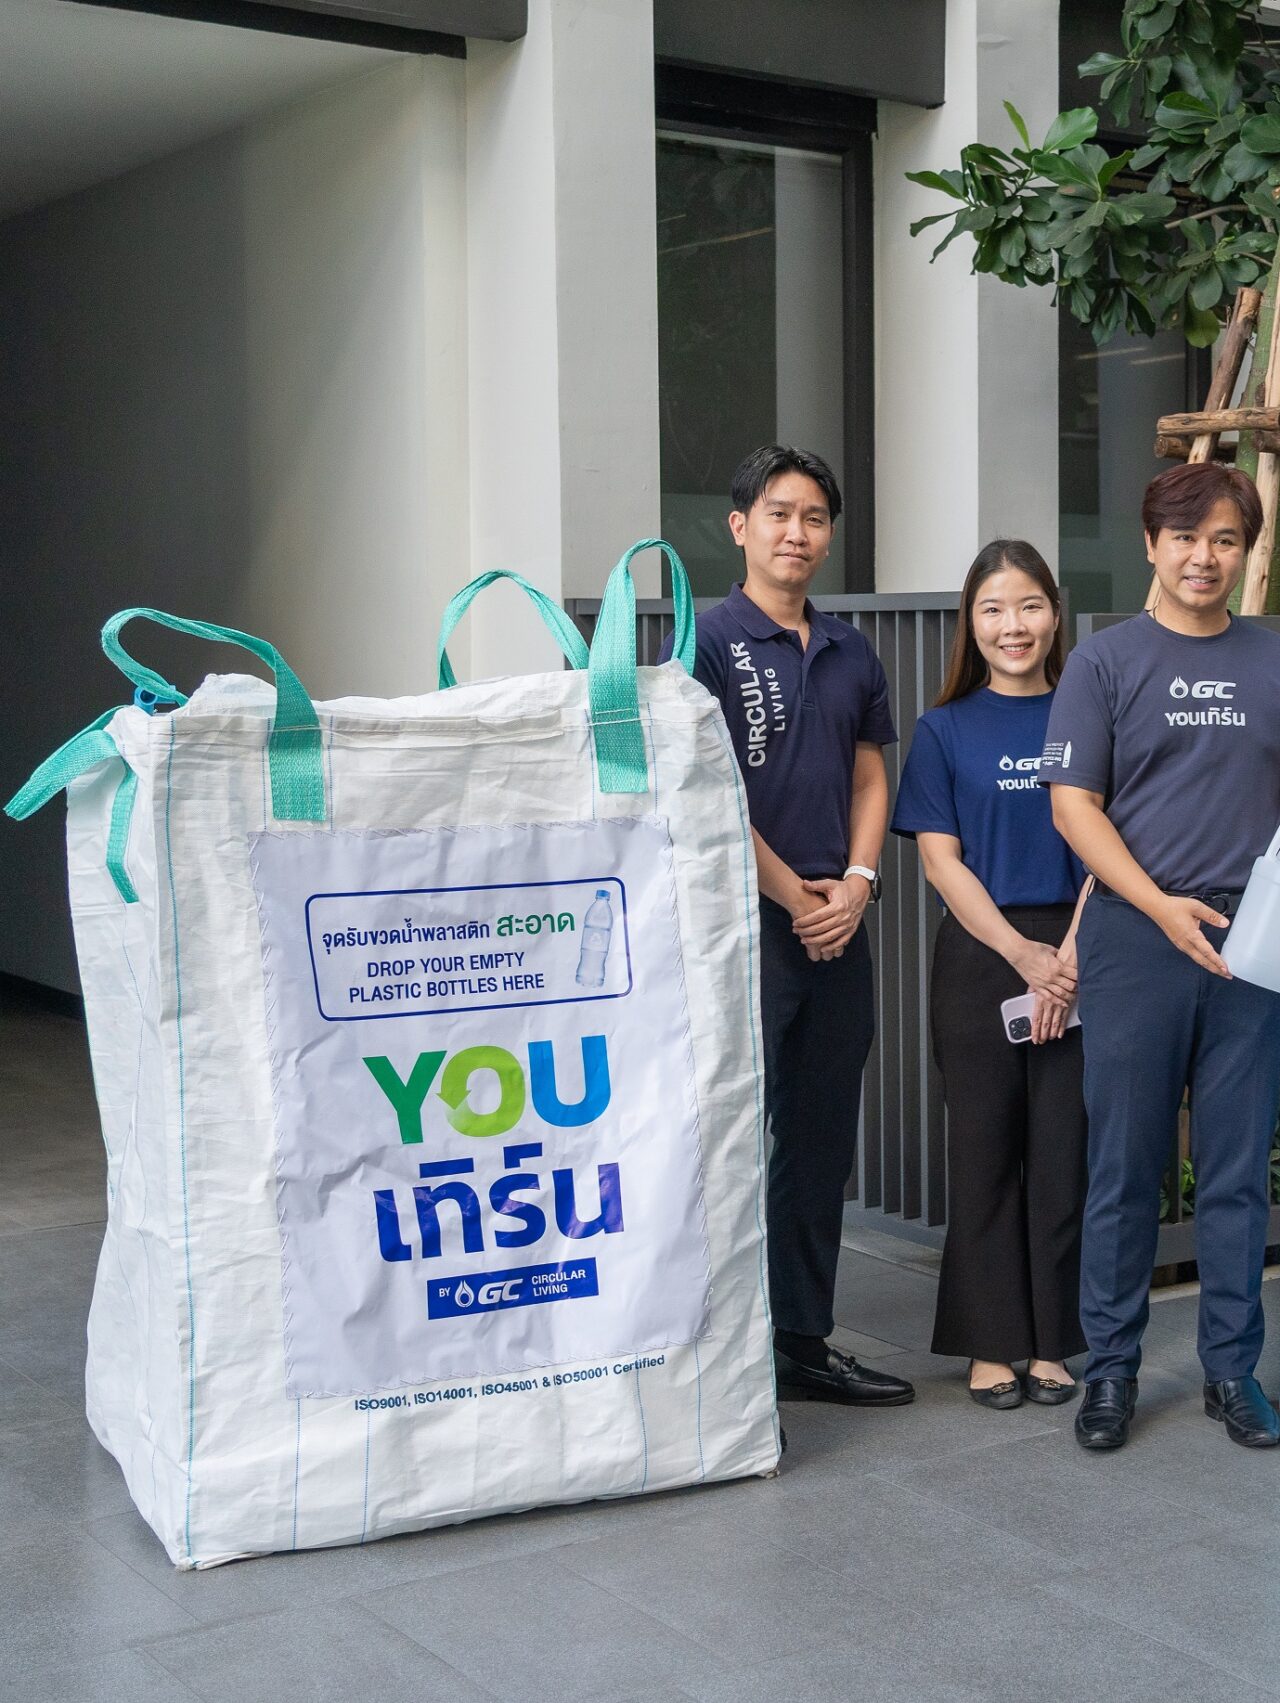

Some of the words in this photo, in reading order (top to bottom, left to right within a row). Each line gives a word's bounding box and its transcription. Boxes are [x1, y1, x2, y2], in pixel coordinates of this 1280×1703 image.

[730, 641, 767, 767] CIRCULAR
[764, 668, 786, 732] LIVING
[1191, 680, 1237, 699] GC
[322, 918, 490, 954] จุดรับขวดน้ำพลาสติก
[496, 912, 575, 937] สะอาด
[367, 960, 415, 978] DROP
[420, 955, 465, 974] YOUR
[470, 952, 525, 970] EMPTY
[349, 983, 421, 1003] PLASTIC
[427, 977, 498, 998] BOTTLES
[503, 973, 545, 991] HERE
[362, 1035, 612, 1144] YOU
[439, 1287, 450, 1298] BY
[478, 1279, 523, 1305] GC
[531, 1269, 586, 1285] CIRCULAR
[533, 1284, 568, 1297] LIVING
[355, 1394, 411, 1411] ISO9001,
[414, 1387, 477, 1405] ISO14001,
[481, 1379, 538, 1396] ISO45001
[542, 1376, 551, 1387] &
[553, 1366, 609, 1386] ISO50001
[613, 1355, 665, 1376] Certified
